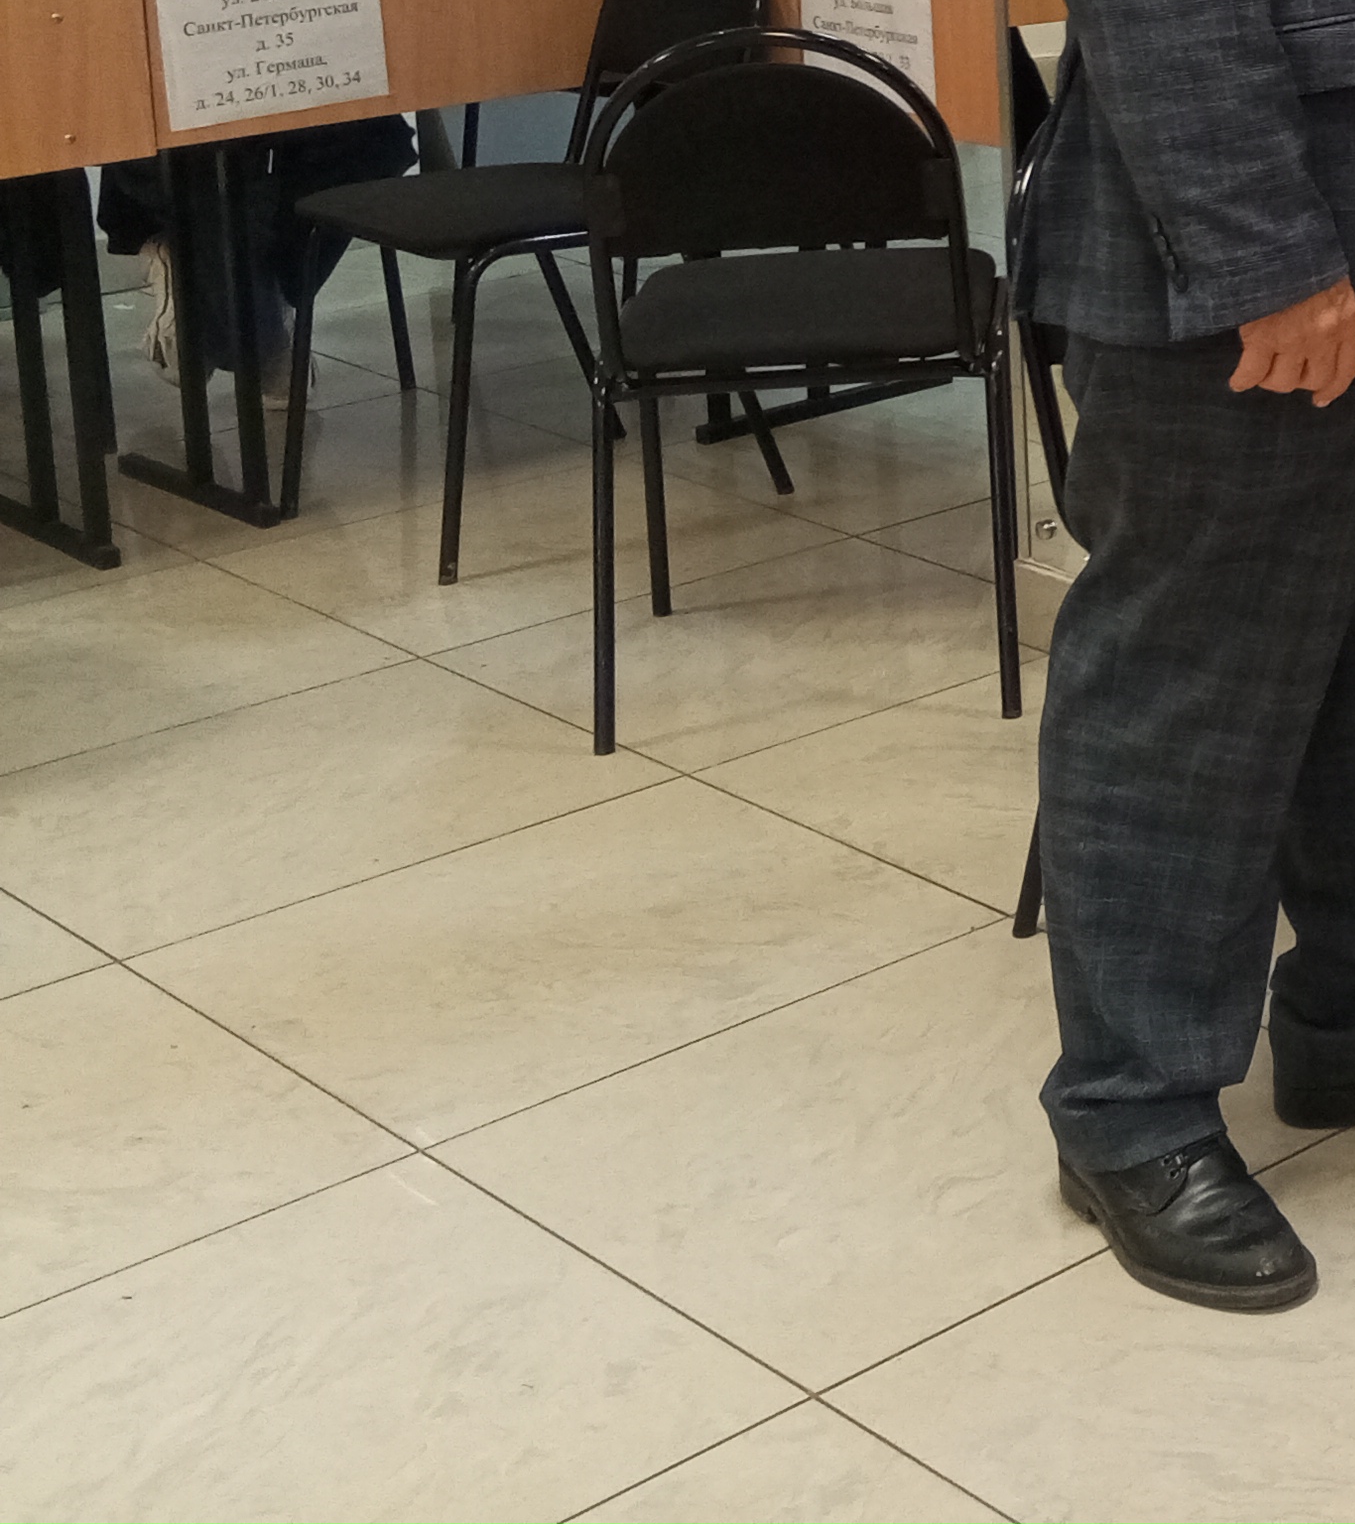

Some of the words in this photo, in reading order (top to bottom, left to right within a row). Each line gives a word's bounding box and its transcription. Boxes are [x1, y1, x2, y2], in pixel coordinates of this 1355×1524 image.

[183, 0, 359, 38] Санкт-Петербургская
[255, 39, 270, 52] д.
[276, 32, 294, 49] 35
[226, 68, 250, 84] ул.
[344, 70, 362, 85] 34
